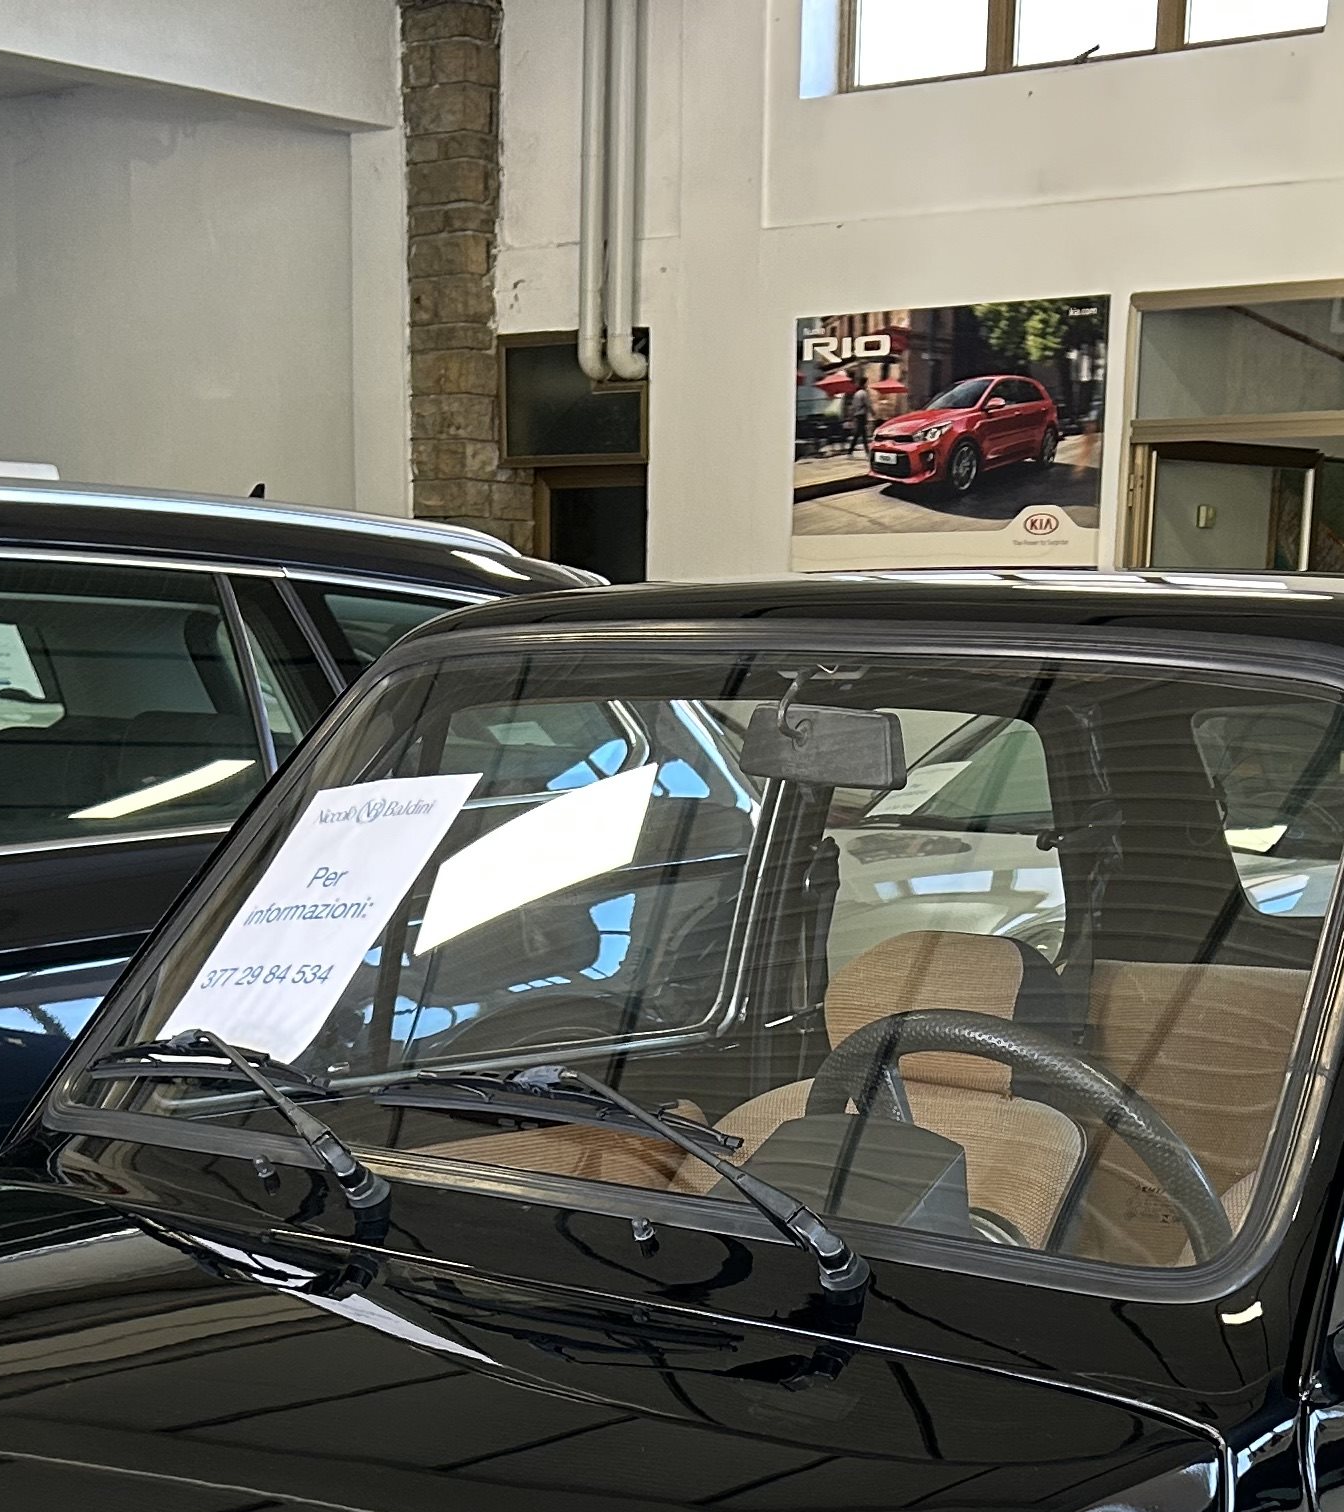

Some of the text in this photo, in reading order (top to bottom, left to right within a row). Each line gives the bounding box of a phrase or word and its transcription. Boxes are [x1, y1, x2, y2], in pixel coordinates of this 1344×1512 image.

[1029, 517, 1053, 530] KIA
[383, 799, 436, 817] Baldini
[306, 866, 349, 888] Per
[243, 897, 374, 926] informazioni:
[200, 964, 335, 989] 377 29 84 534
